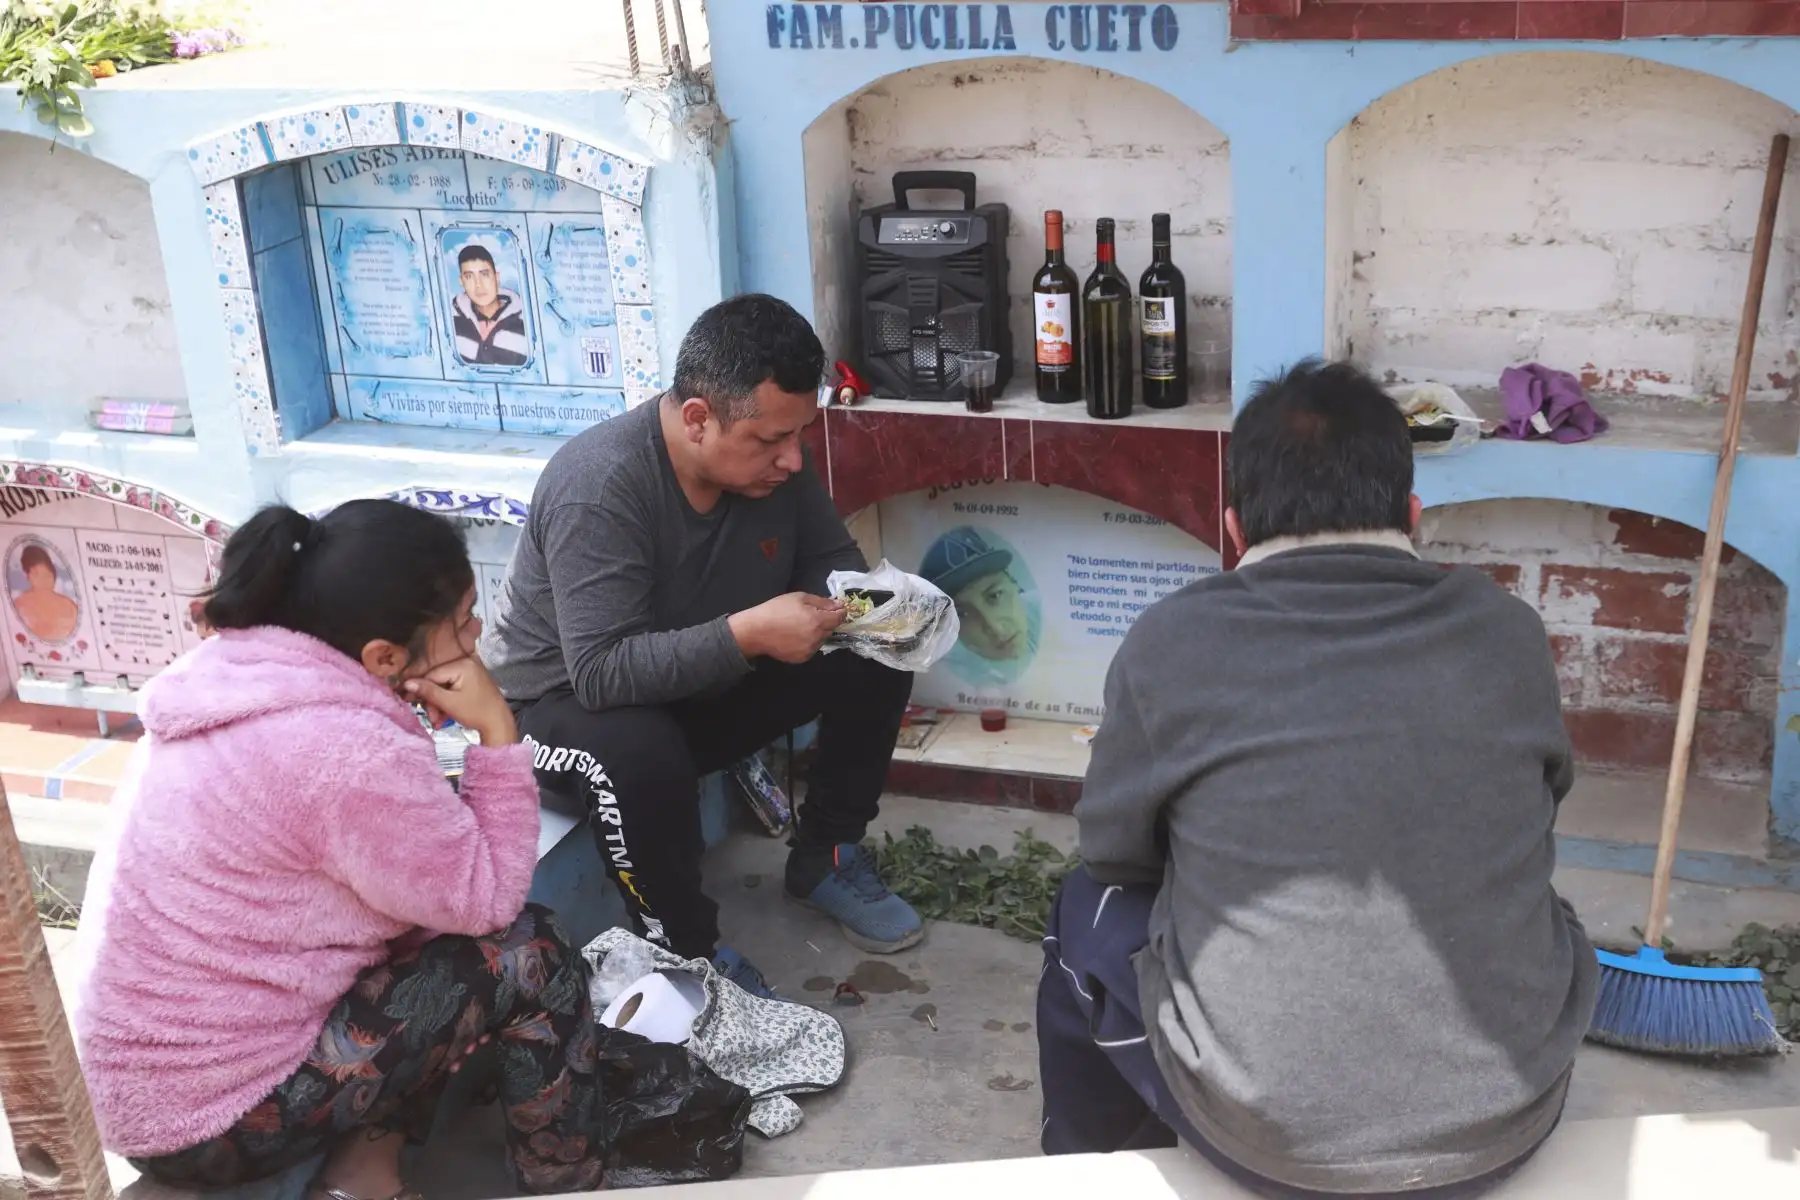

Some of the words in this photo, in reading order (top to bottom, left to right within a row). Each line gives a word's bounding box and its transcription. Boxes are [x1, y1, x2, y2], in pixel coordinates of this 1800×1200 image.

[1044, 4, 1180, 51] CUETO
[323, 148, 398, 185] ULISES
[428, 399, 446, 418] por
[448, 400, 490, 420] siempre
[510, 403, 556, 420] nuestros
[1088, 556, 1139, 569] lamenten
[1141, 560, 1154, 570] mi
[1156, 561, 1195, 573] partida
[1068, 568, 1090, 580] bien
[1092, 570, 1128, 583] cierren
[1130, 574, 1148, 584] sus
[1068, 583, 1128, 597] pronuncien
[1133, 586, 1147, 598] mi
[1106, 599, 1120, 609] mi
[1070, 611, 1112, 624] elevado
[1025, 698, 1041, 711] de
[1045, 702, 1061, 713] su
